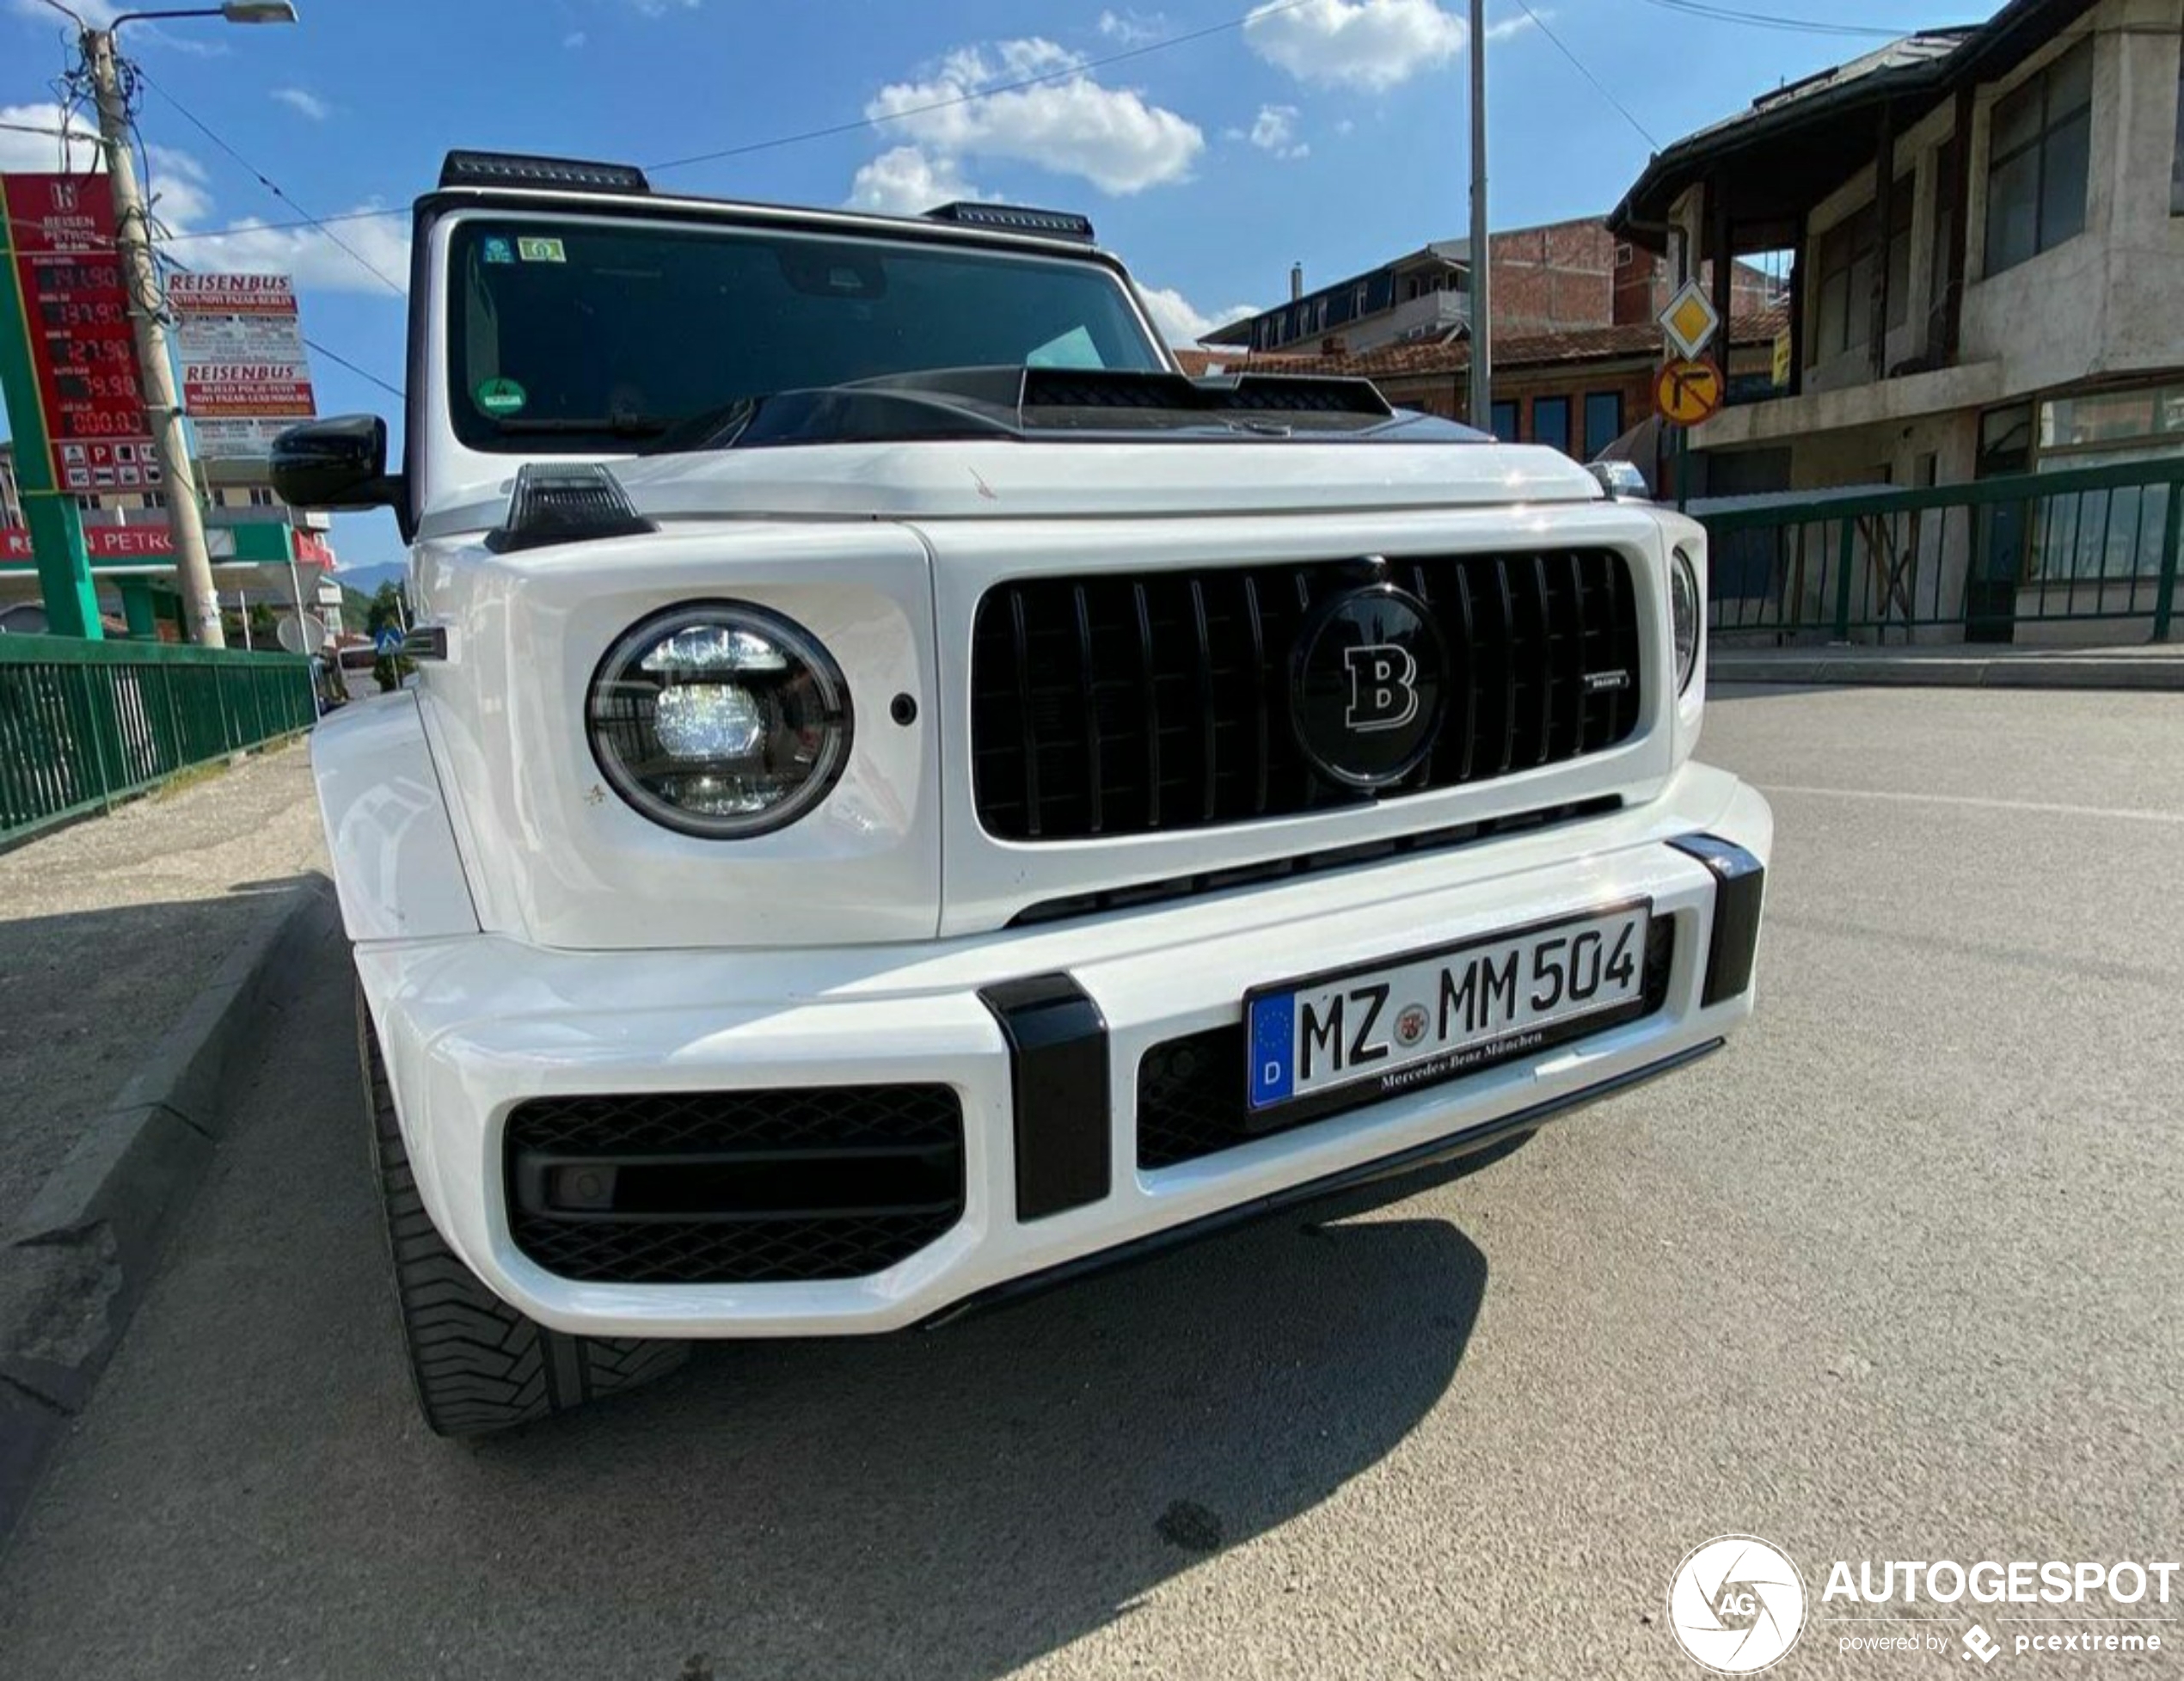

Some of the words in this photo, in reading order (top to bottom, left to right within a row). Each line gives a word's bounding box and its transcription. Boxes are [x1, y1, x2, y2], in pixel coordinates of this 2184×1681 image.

[169, 274, 289, 291] REISENBUS
[187, 365, 294, 381] REISENBUS
[1344, 643, 1419, 733] B
[1300, 983, 1390, 1081] MZ
[1437, 949, 1519, 1041] MM
[1531, 921, 1635, 1013] 504
[1264, 1061, 1281, 1085] D
